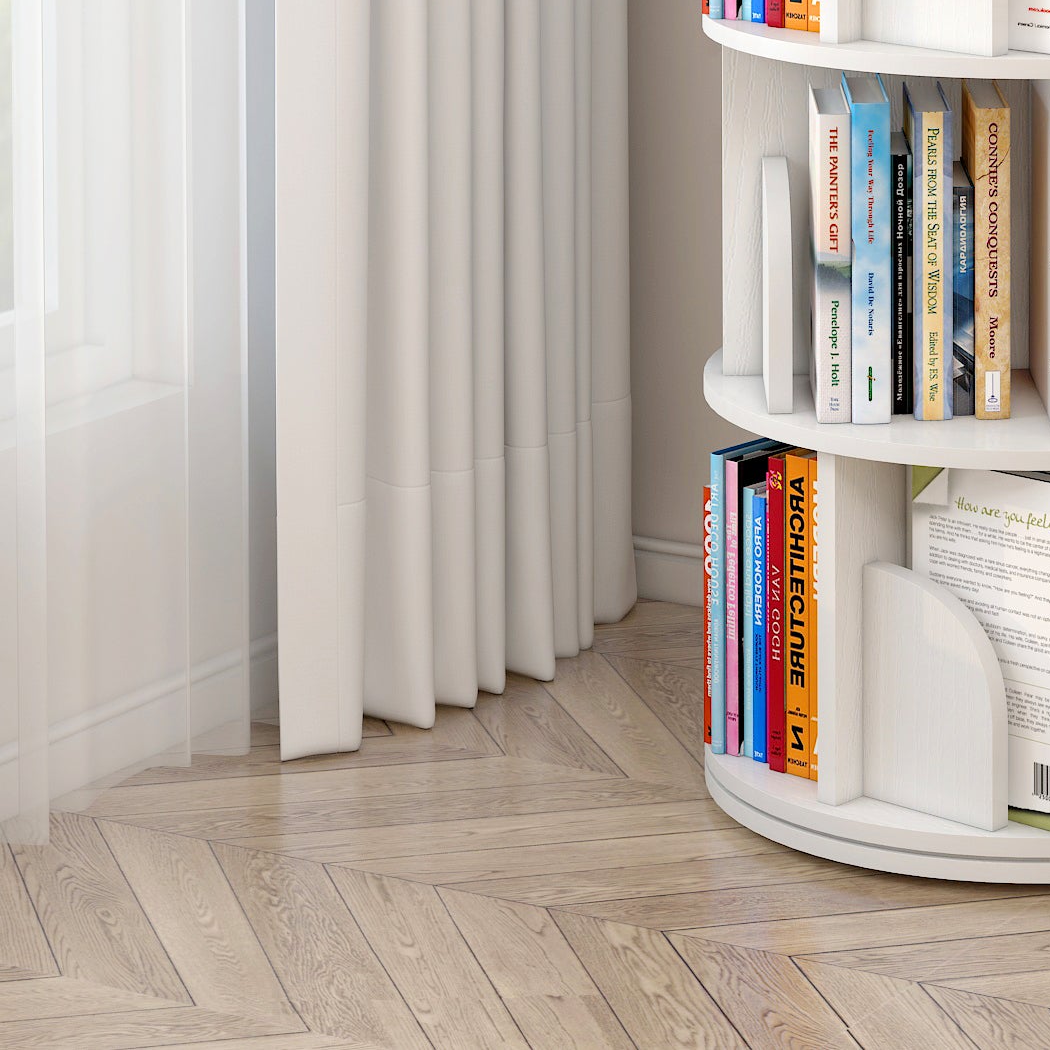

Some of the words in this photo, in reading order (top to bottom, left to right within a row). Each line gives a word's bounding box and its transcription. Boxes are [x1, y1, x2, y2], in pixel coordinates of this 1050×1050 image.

[830, 126, 838, 152] THE
[928, 128, 939, 166] PEARLS
[989, 123, 998, 197] CONNIE'S
[830, 157, 838, 220] PAINTER'S
[928, 168, 937, 198] FROM
[928, 200, 937, 220] THE
[830, 224, 838, 252] GIFT
[928, 223, 940, 250] SEAT
[987, 202, 998, 298] CONQUESTS
[928, 255, 937, 267] OF
[928, 270, 940, 314] WISDOM
[829, 300, 839, 349] Penelope
[990, 317, 998, 358] Moore
[954, 497, 979, 514] How
[981, 506, 1000, 518] are
[1003, 510, 1023, 528] you
